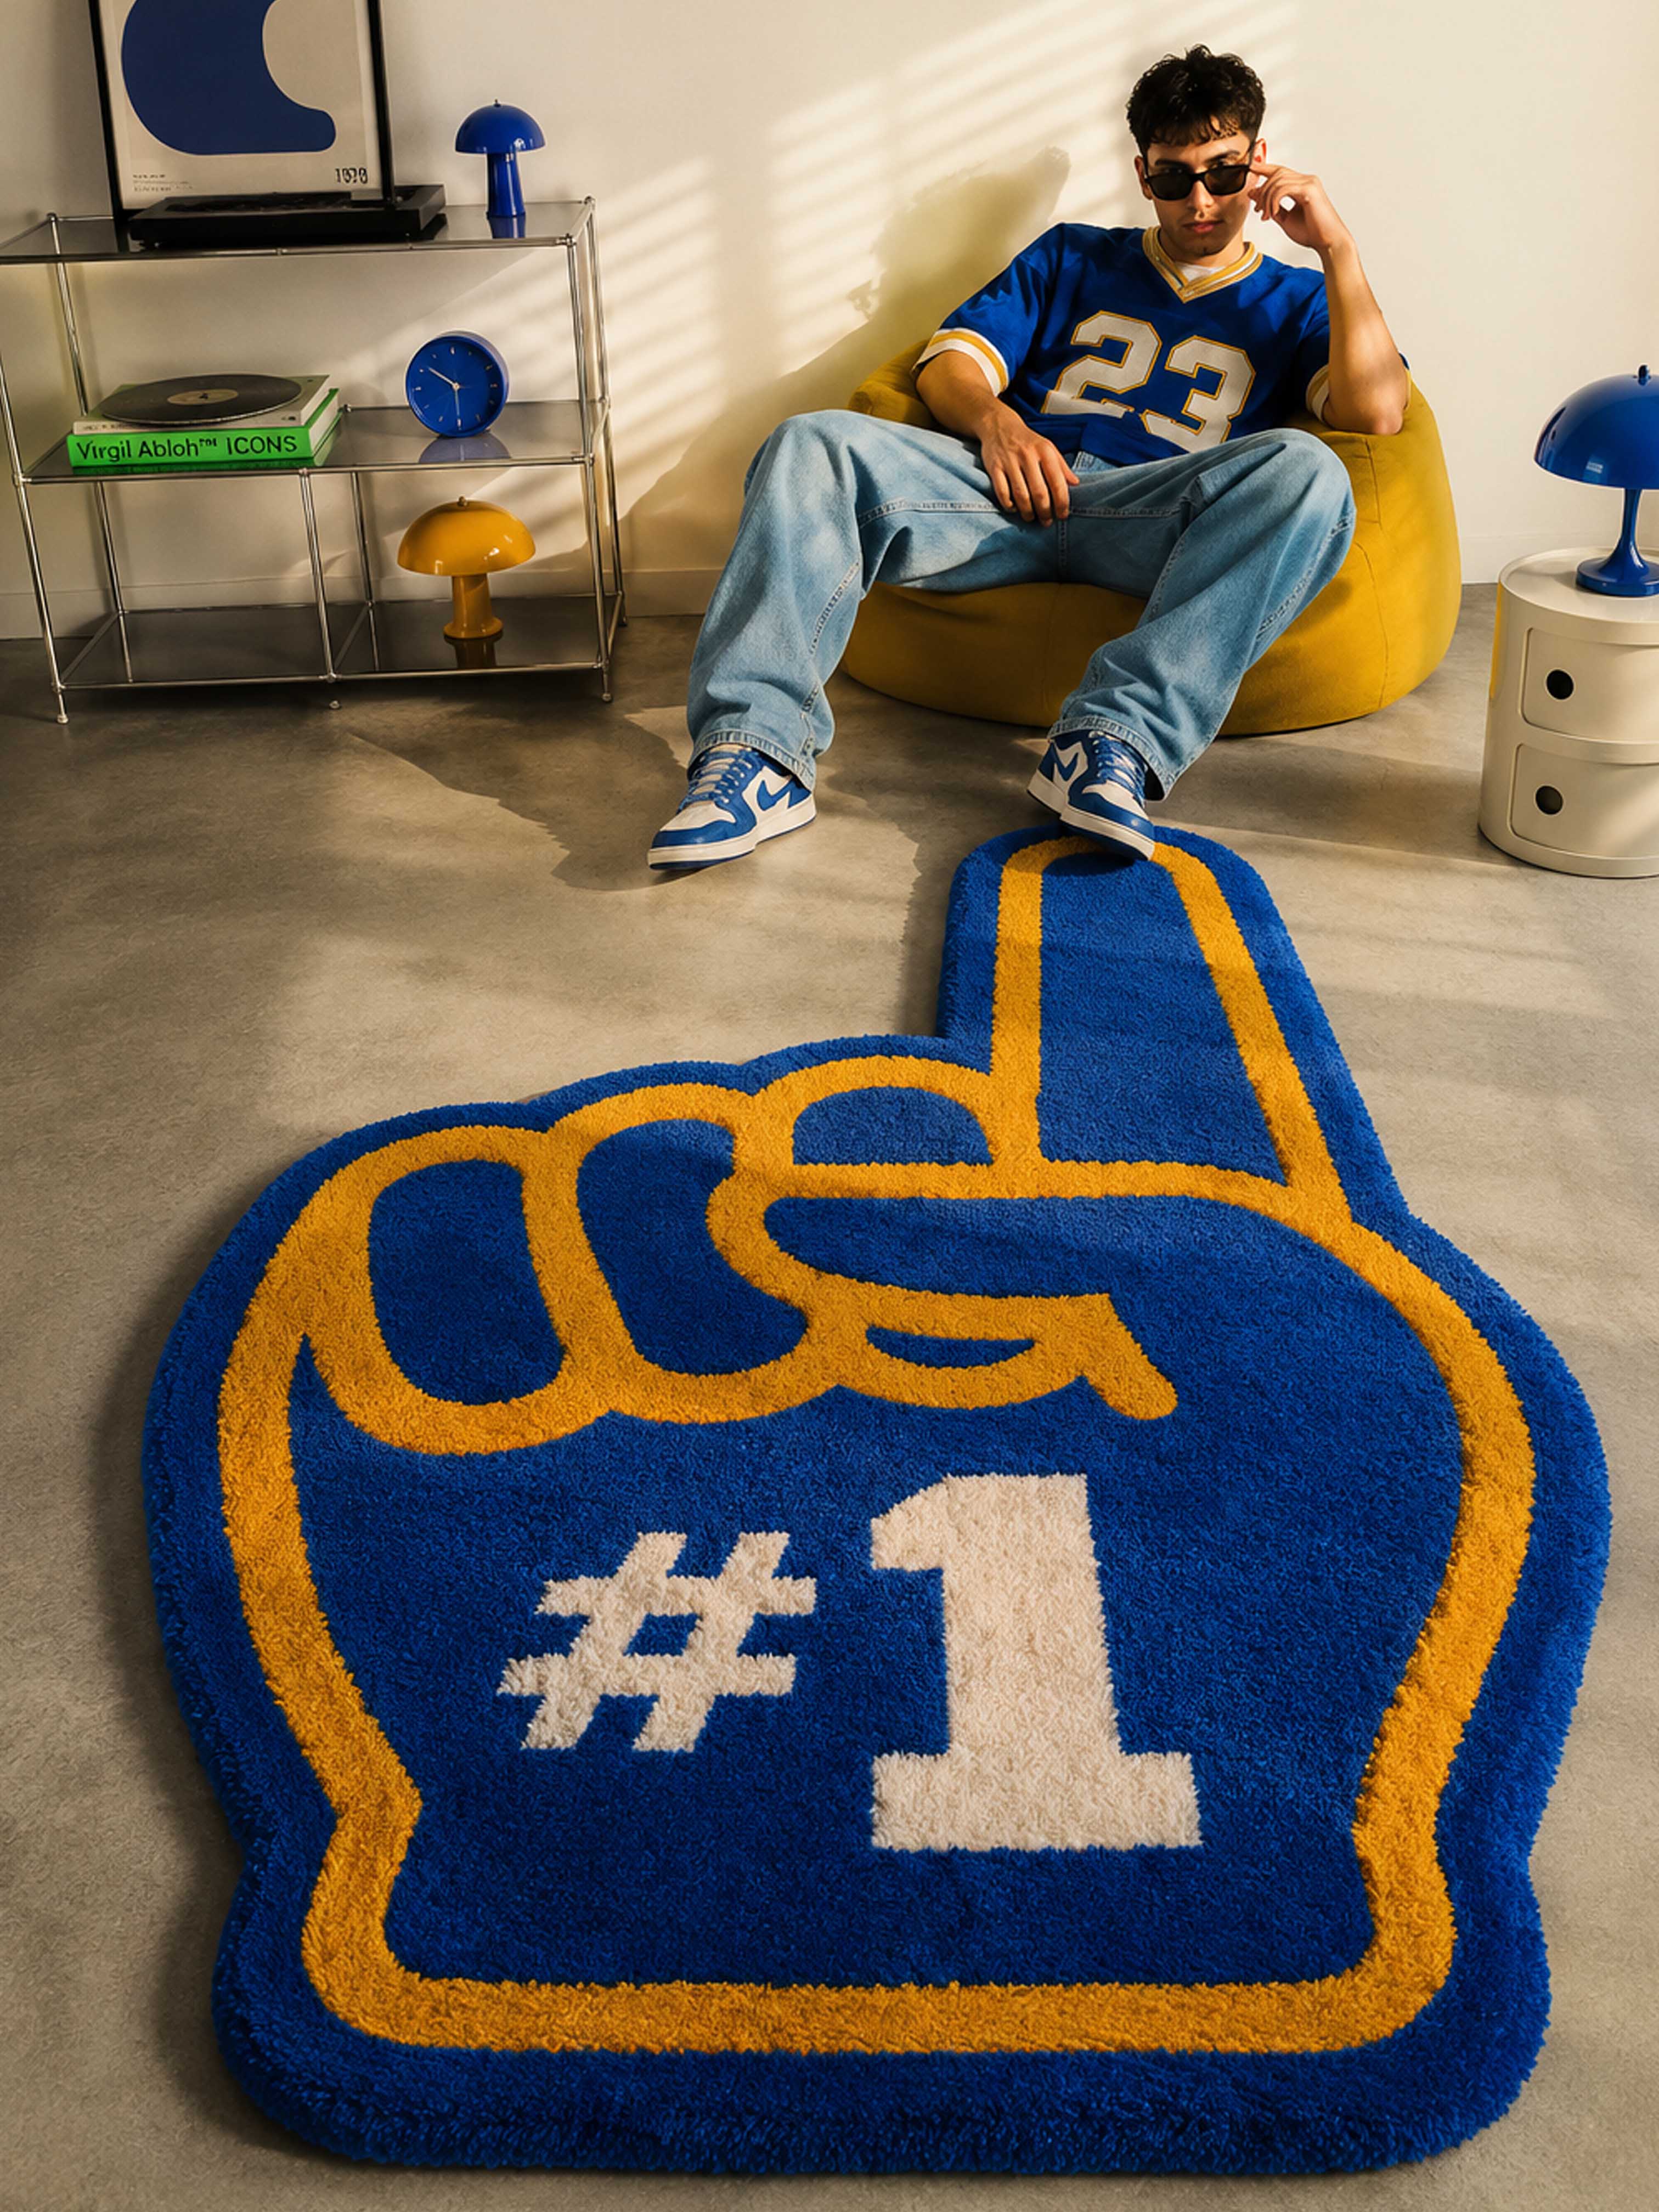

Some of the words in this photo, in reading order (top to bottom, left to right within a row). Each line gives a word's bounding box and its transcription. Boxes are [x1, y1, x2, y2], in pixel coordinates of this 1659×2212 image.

[1041, 310, 1257, 454] 23
[76, 440, 132, 462] Virgil
[226, 436, 298, 455] ICONS
